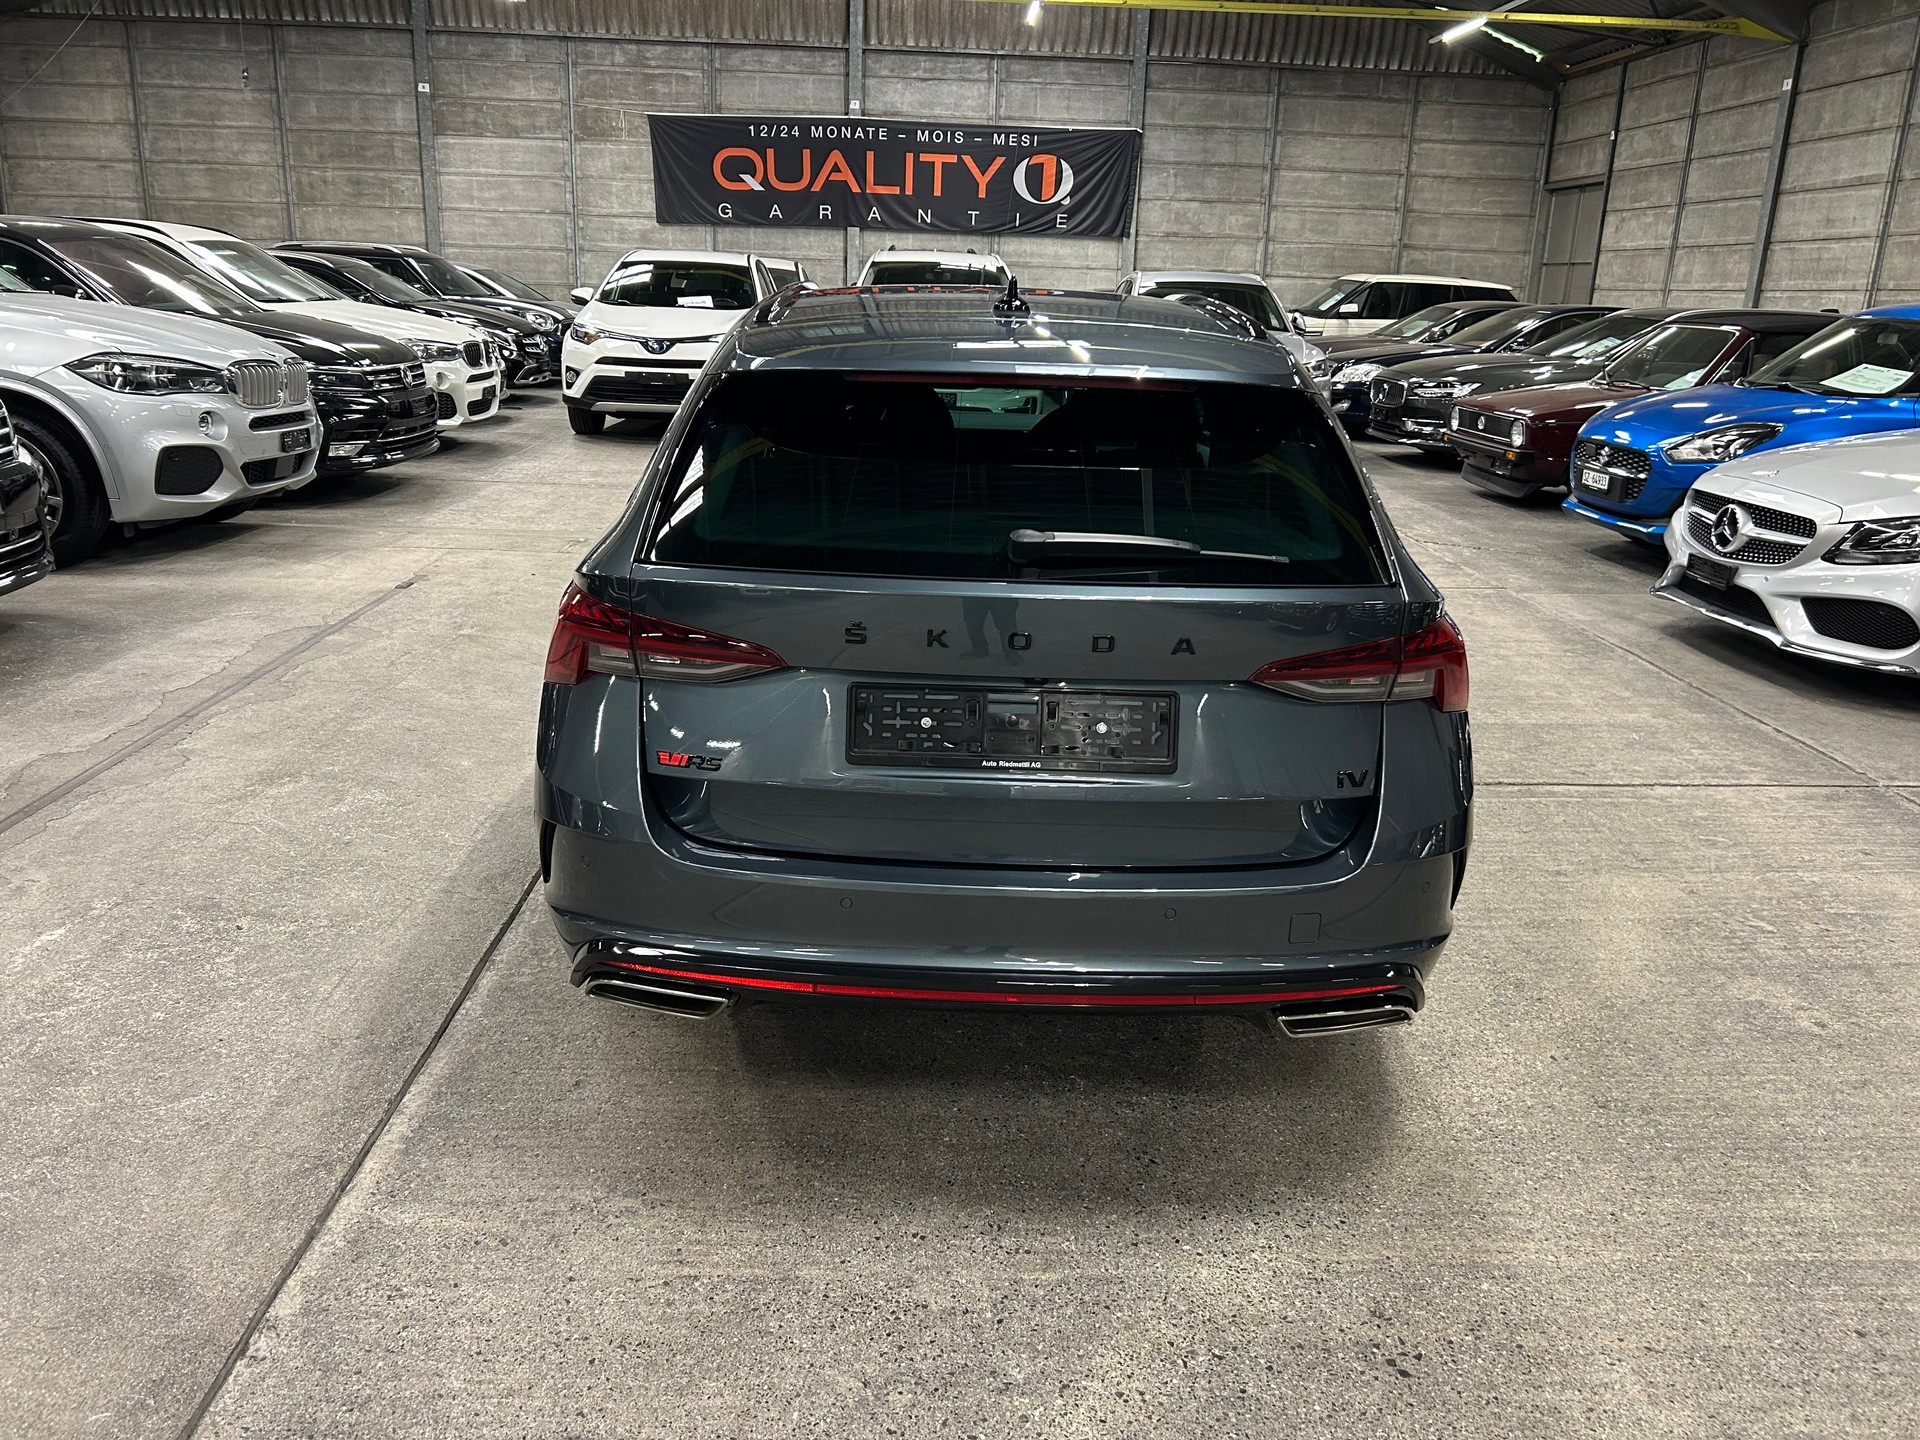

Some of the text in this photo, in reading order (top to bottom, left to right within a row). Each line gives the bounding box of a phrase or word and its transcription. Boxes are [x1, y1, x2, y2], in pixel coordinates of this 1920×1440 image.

[748, 125, 800, 138] 12/24
[810, 126, 888, 140] MONATE
[916, 130, 964, 144] MOIS
[992, 133, 1038, 147] MESI
[712, 147, 1007, 199] QUALITY
[718, 202, 1069, 228] GARANTIE
[1030, 761, 1041, 769] AG
